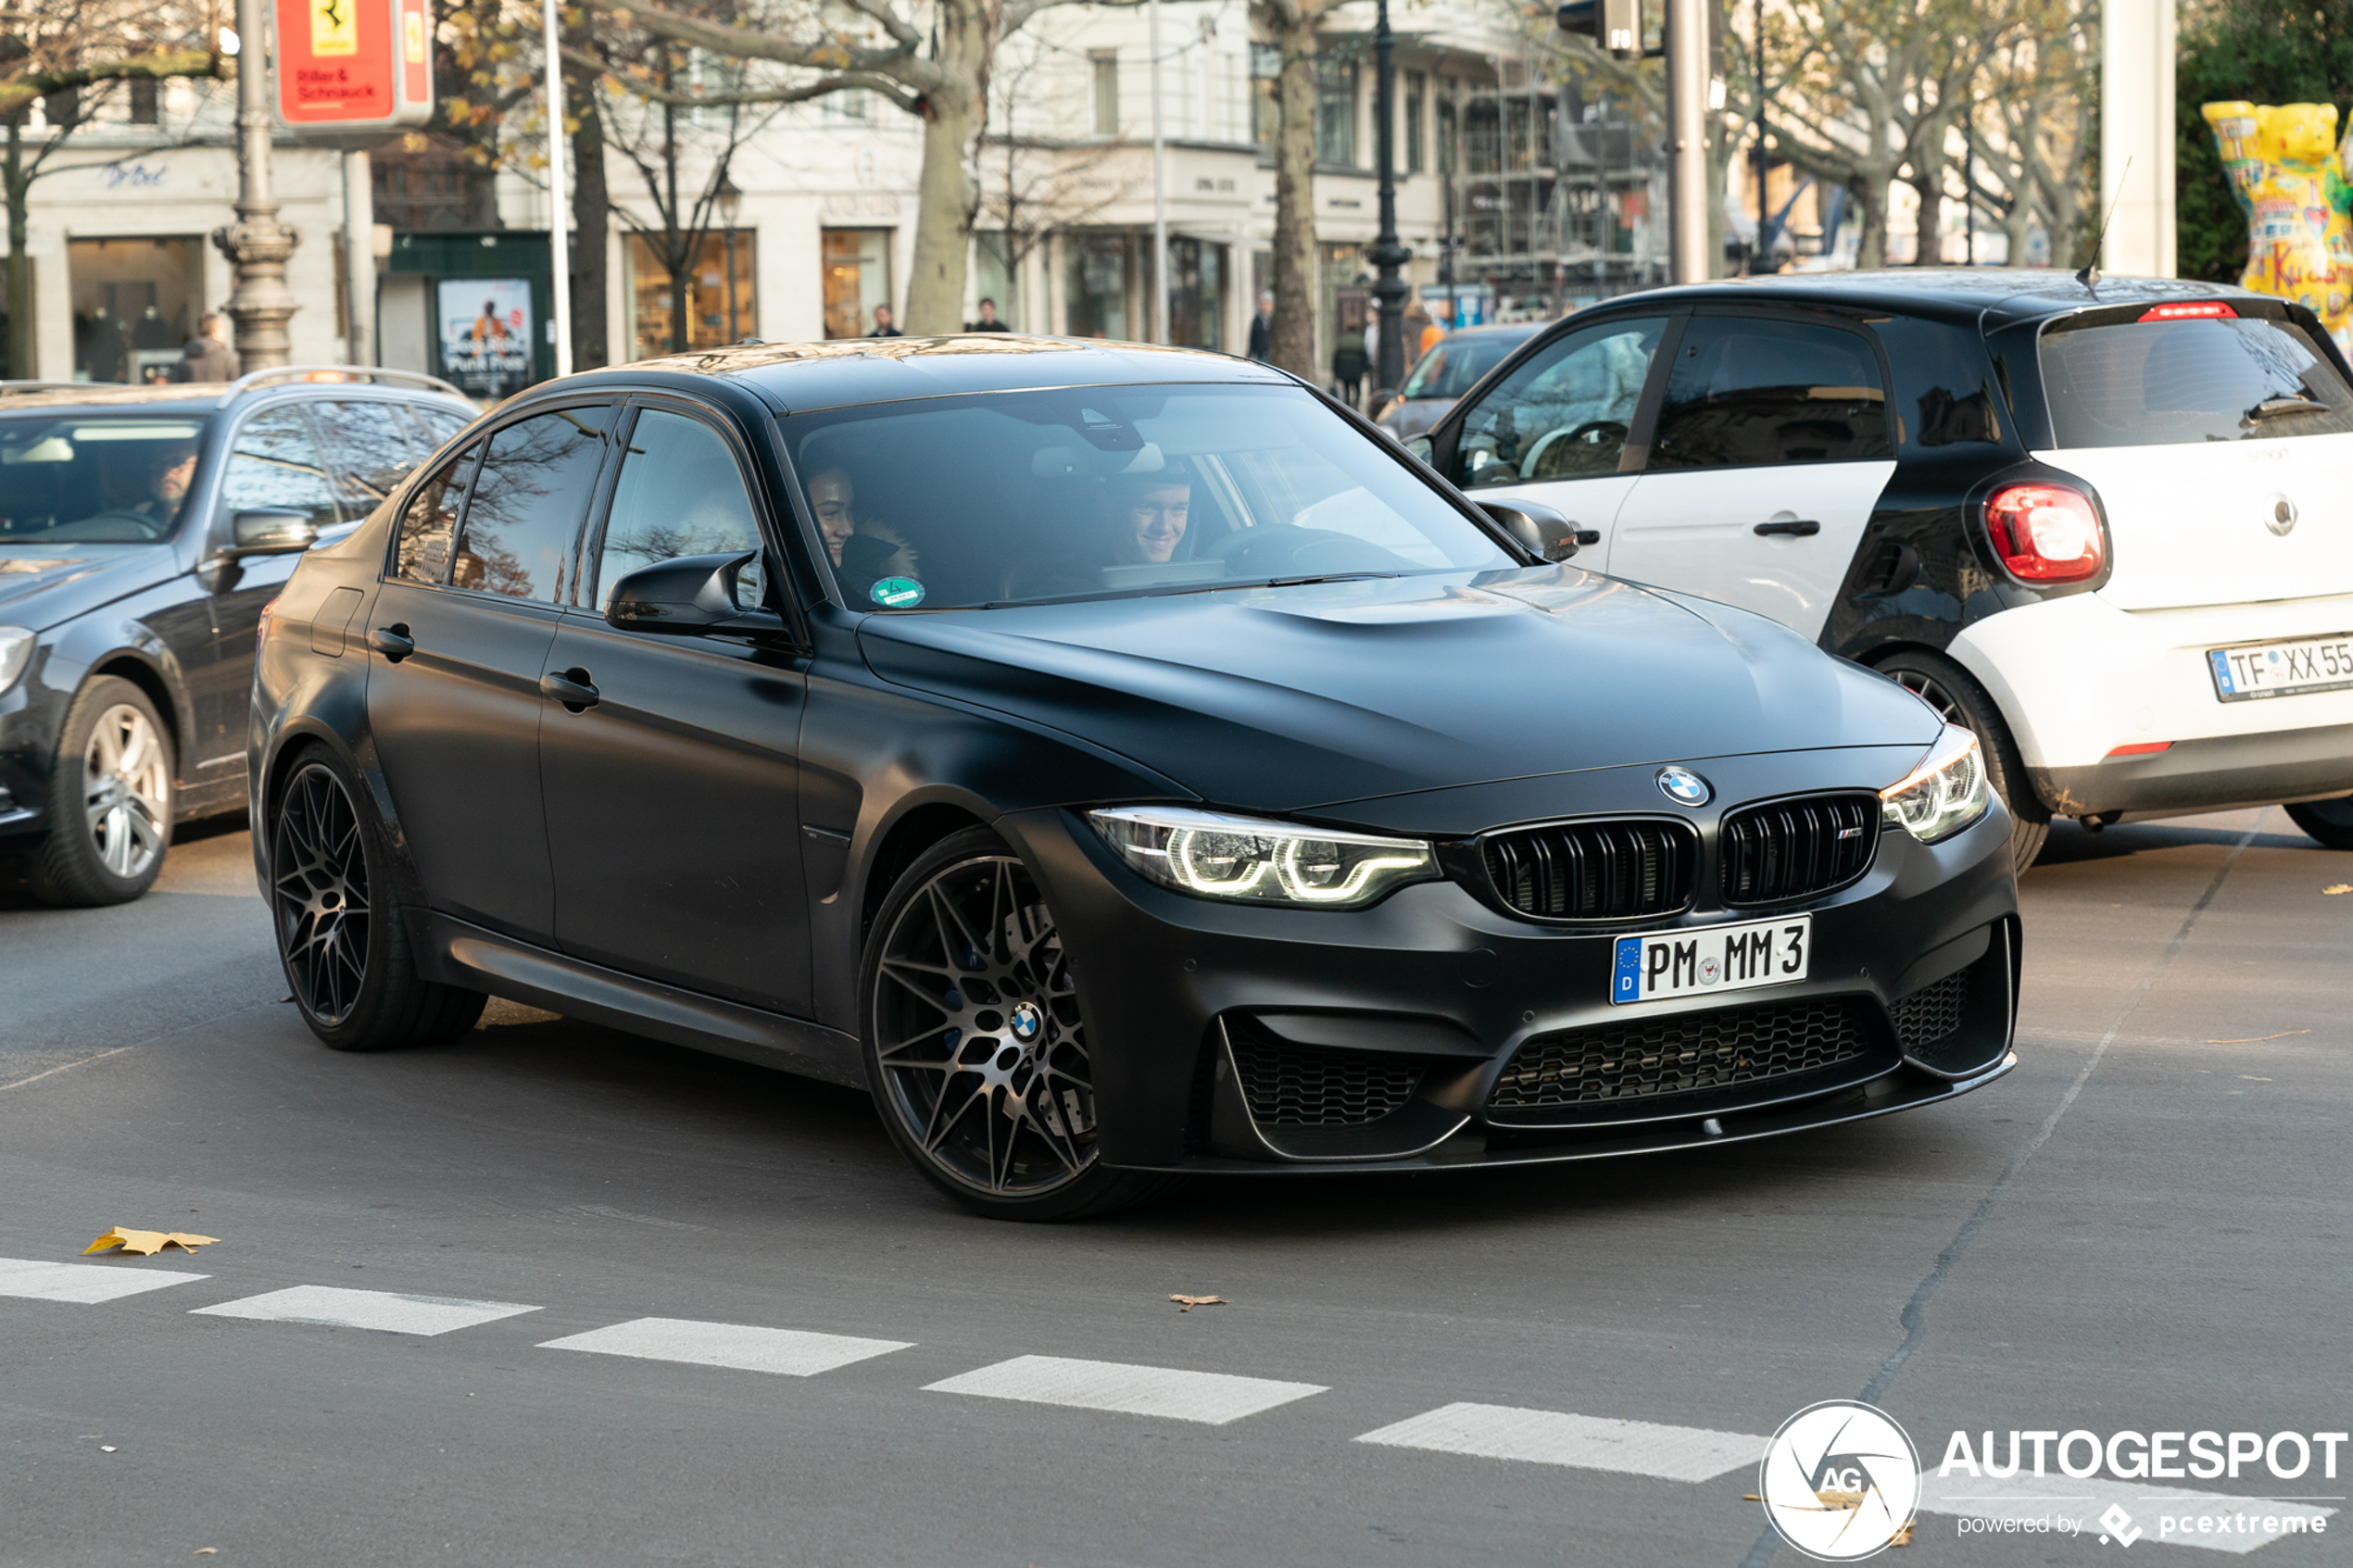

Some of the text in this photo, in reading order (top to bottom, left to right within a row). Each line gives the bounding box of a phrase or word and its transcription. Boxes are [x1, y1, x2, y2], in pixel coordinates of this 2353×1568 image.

[338, 69, 347, 82] &
[889, 582, 901, 593] 4
[2231, 653, 2264, 686] TF
[2284, 647, 2321, 680] XX
[1622, 925, 1804, 992] D PM MM 3
